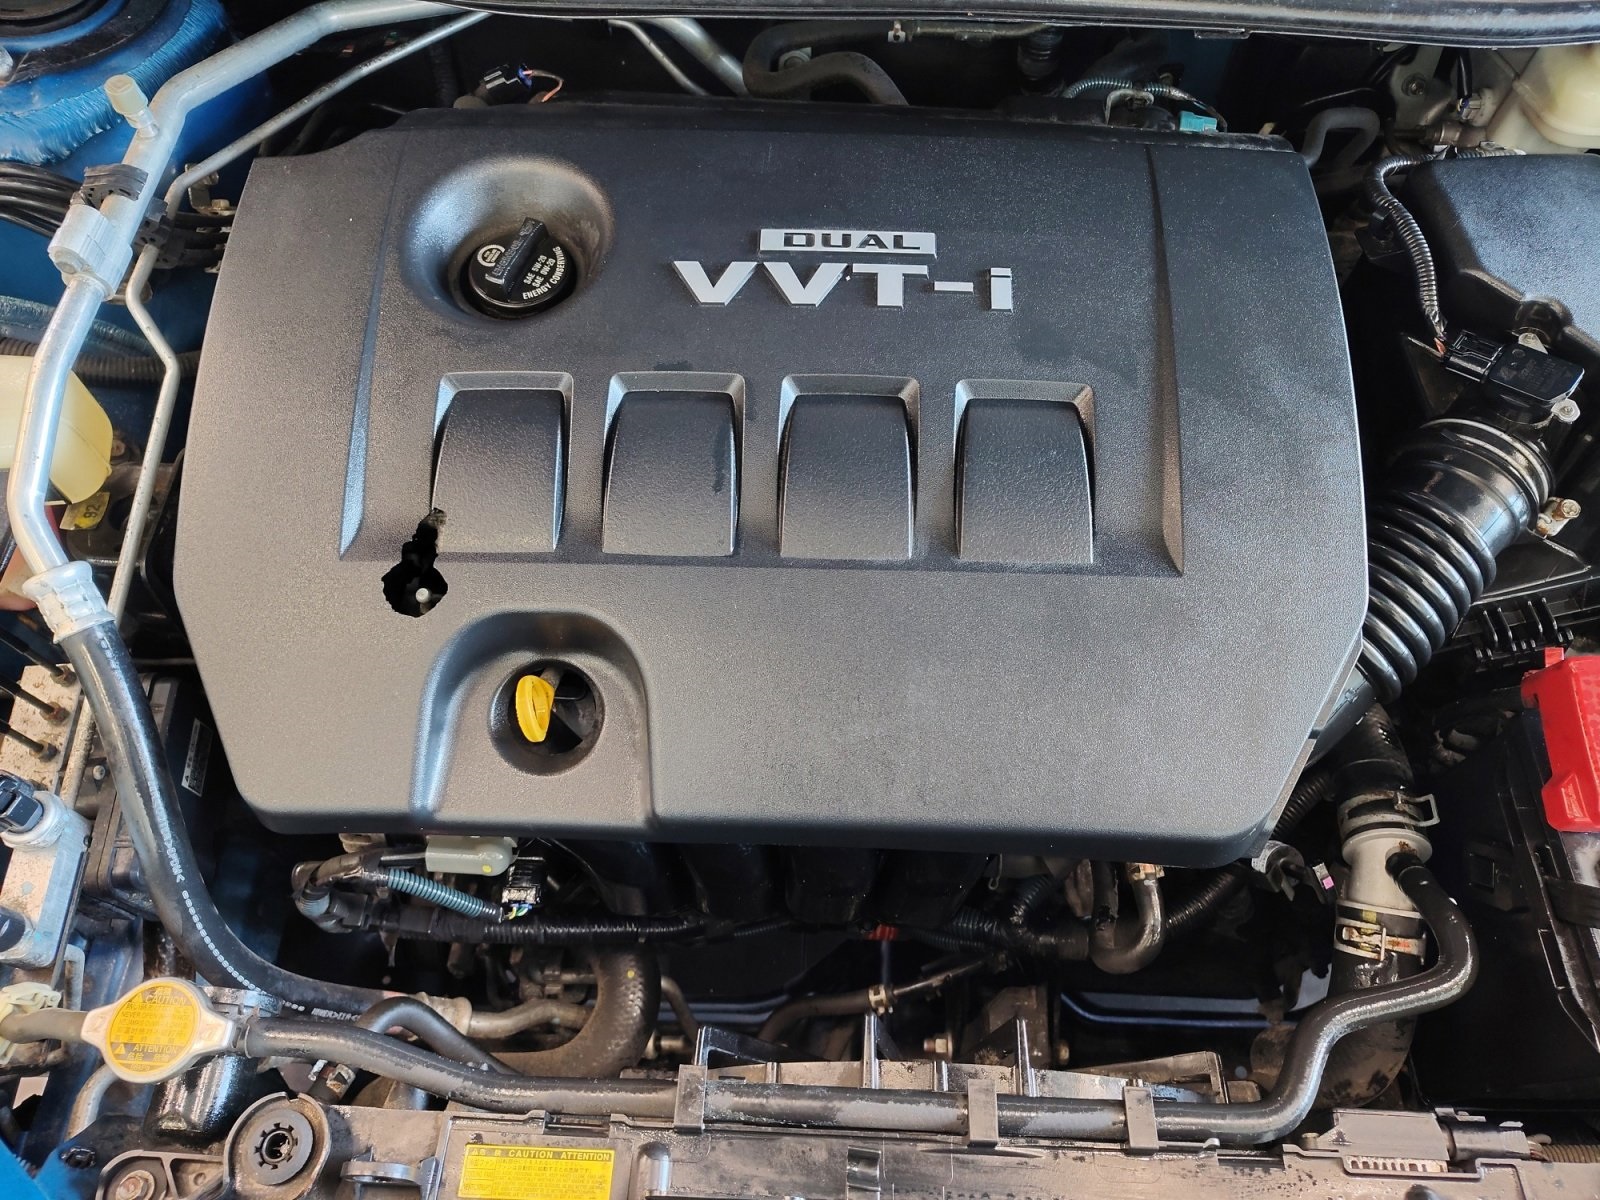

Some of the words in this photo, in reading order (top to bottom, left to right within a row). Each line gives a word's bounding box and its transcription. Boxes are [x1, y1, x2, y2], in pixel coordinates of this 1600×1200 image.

[783, 232, 921, 250] DUAL
[522, 282, 552, 300] ENERGY
[550, 246, 565, 285] CONSERVING
[523, 272, 536, 285] SAE
[531, 254, 547, 272] 5W-20
[531, 275, 544, 288] SAE
[673, 261, 1013, 312] VVT-i
[145, 995, 186, 1005] CAUTION
[133, 1043, 178, 1054] ATTENTION
[508, 1149, 554, 1159] CAUTION
[560, 1152, 610, 1161] ATTENTION
